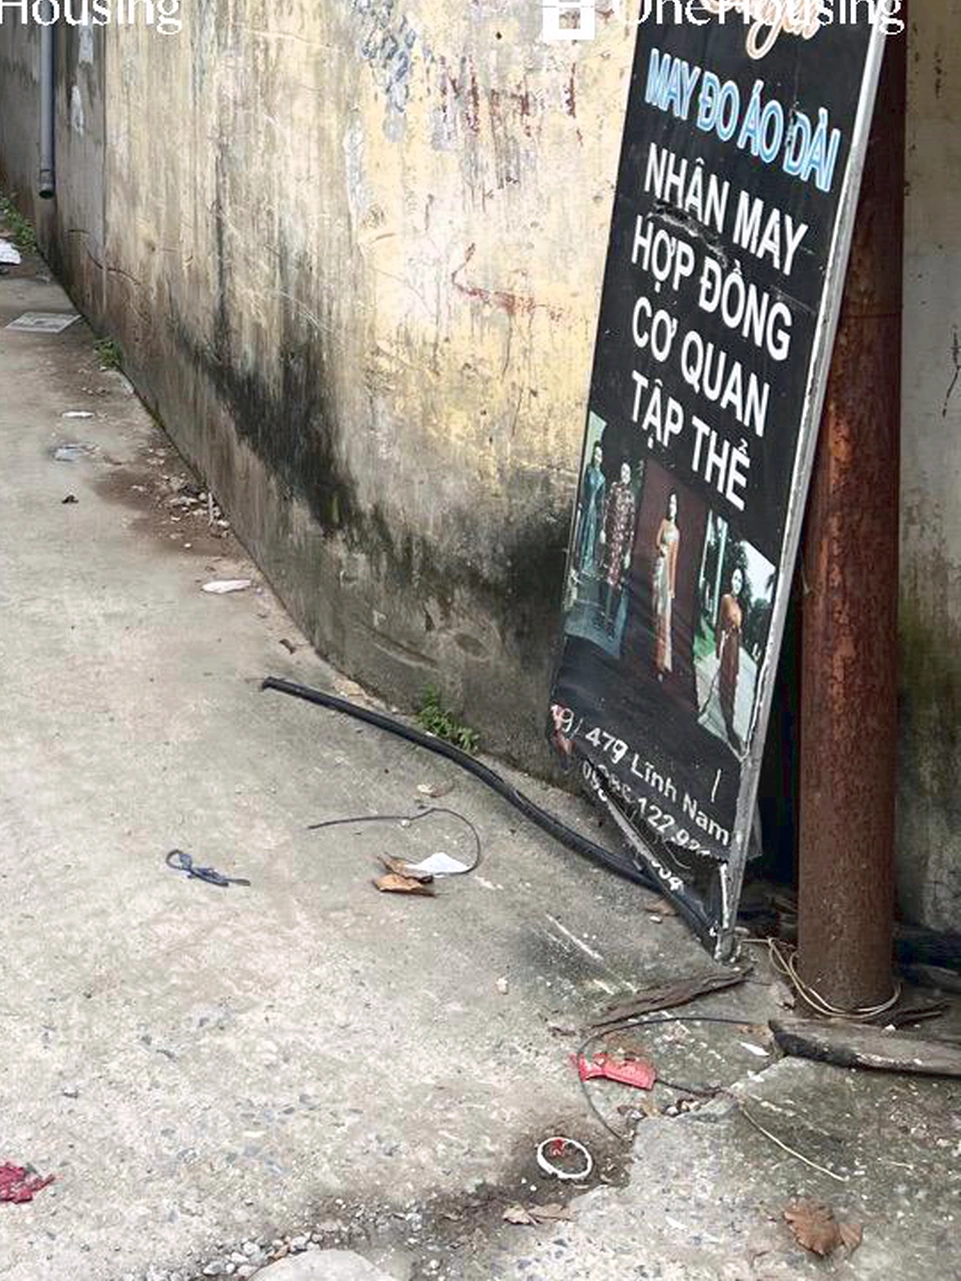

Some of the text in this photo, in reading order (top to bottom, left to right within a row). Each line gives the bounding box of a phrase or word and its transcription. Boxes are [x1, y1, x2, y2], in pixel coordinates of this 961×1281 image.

[645, 48, 840, 192] MAY ĐO ÁO DÀI
[631, 215, 792, 361] HỢP ĐỒNG
[732, 190, 808, 276] MAY
[632, 296, 770, 437] CƠ QUAN
[631, 370, 752, 511] TẬP THỂ
[631, 754, 677, 802] Lĩnh
[682, 793, 730, 846] Nam
